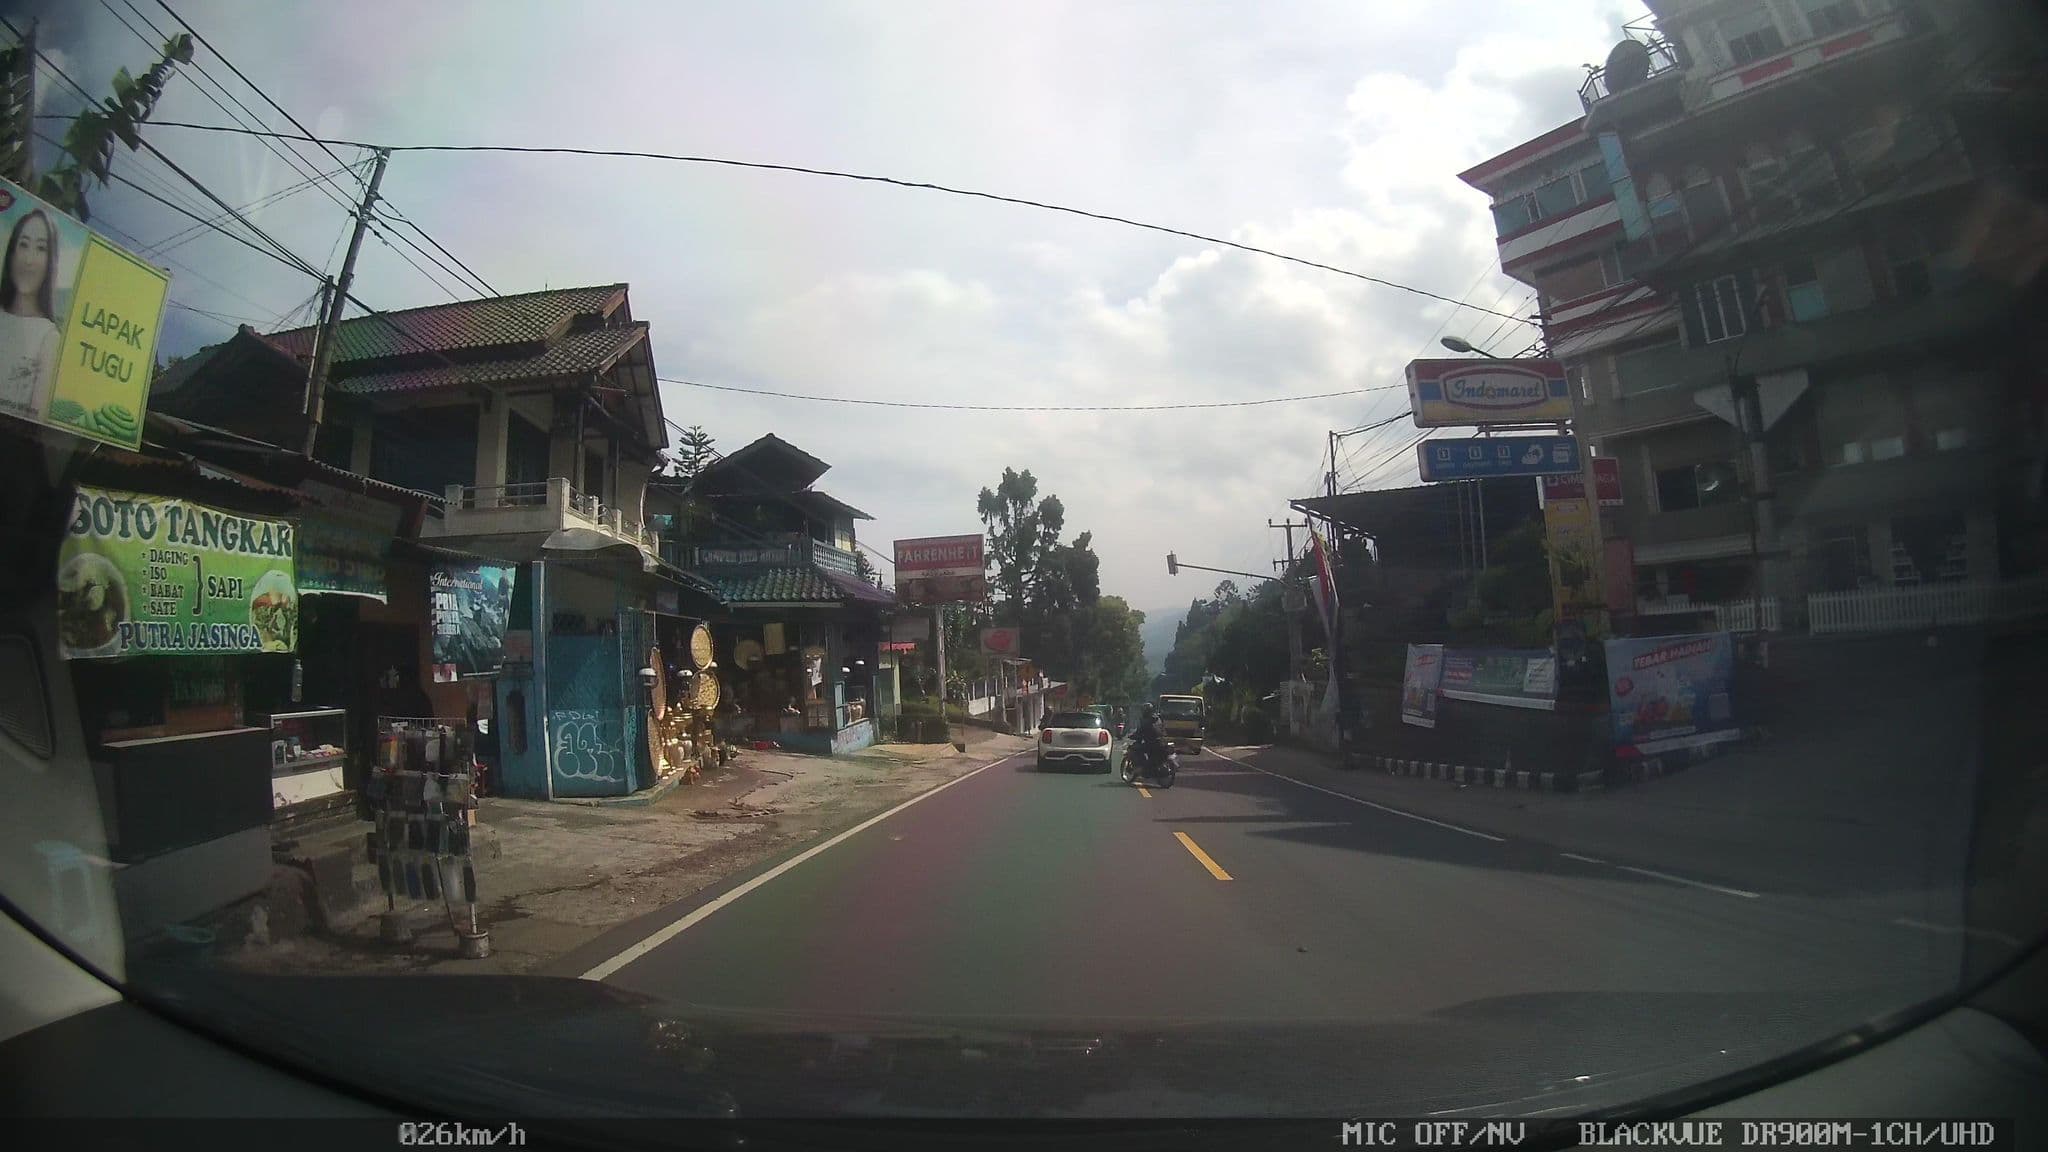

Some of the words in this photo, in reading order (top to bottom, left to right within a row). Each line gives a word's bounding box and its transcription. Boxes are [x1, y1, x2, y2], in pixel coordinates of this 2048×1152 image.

[81, 302, 145, 349] LAPAK
[80, 341, 133, 383] TUGU
[1453, 379, 1542, 399] Indomaret
[71, 493, 158, 540] SOTO
[164, 505, 292, 558] TANGKAR
[150, 551, 189, 565] DAGING
[898, 543, 977, 564] FAHRENHEIT
[150, 567, 167, 580] ISO
[431, 571, 484, 591] International
[208, 576, 243, 599] SAPI
[150, 602, 176, 616] SATE
[436, 592, 459, 610] PRIA
[119, 622, 185, 649] PUTRA
[188, 624, 263, 649] JASINGA
